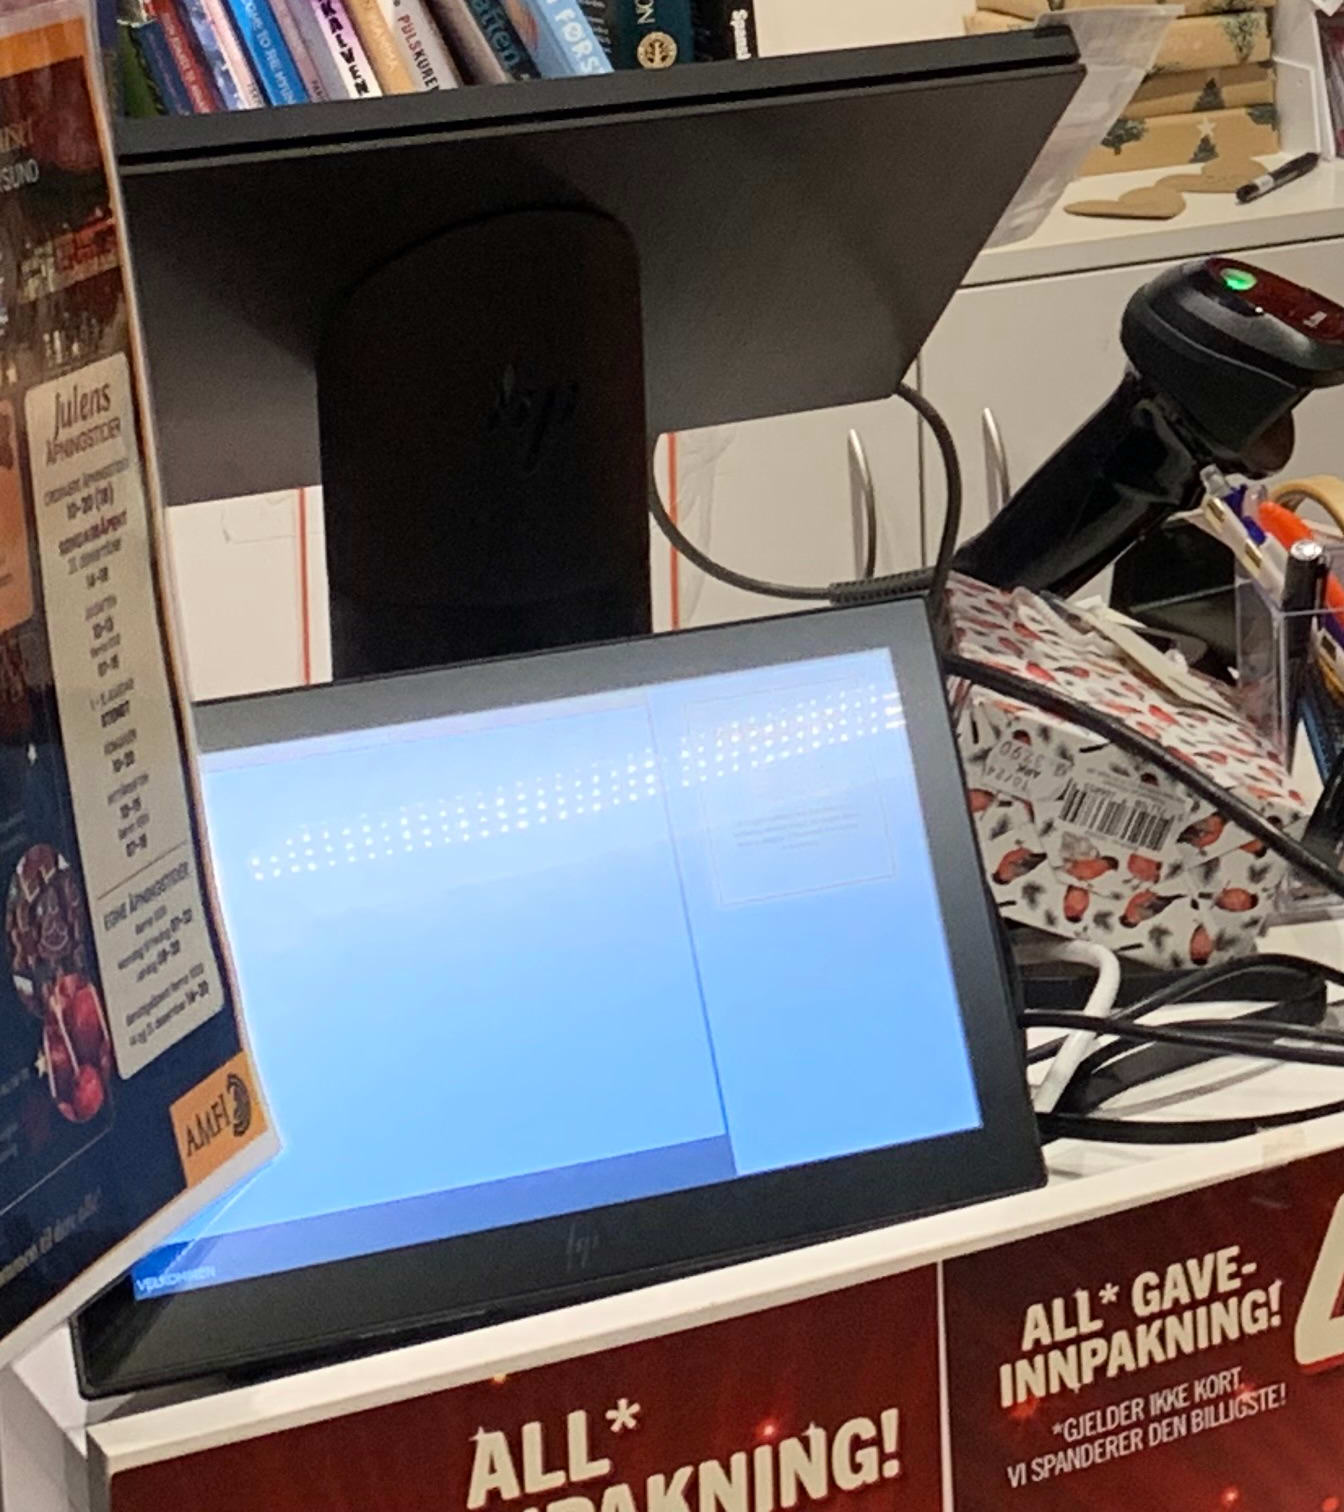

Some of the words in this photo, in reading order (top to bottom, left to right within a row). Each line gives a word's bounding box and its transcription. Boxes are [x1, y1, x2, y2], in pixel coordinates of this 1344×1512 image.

[555, 8, 610, 73] FØRS
[54, 384, 111, 441] Julens
[186, 1094, 230, 1157] AMFI
[1131, 1245, 1257, 1318] GAVE-
[999, 1279, 1283, 1408] INNPAKNING!
[1150, 1383, 1190, 1417] IKKE
[1007, 1462, 1027, 1489] VI
[1030, 1429, 1144, 1483] SPANDERER
[1149, 1415, 1188, 1448] DEN
[1191, 1383, 1288, 1435] BILLIGSTE!
